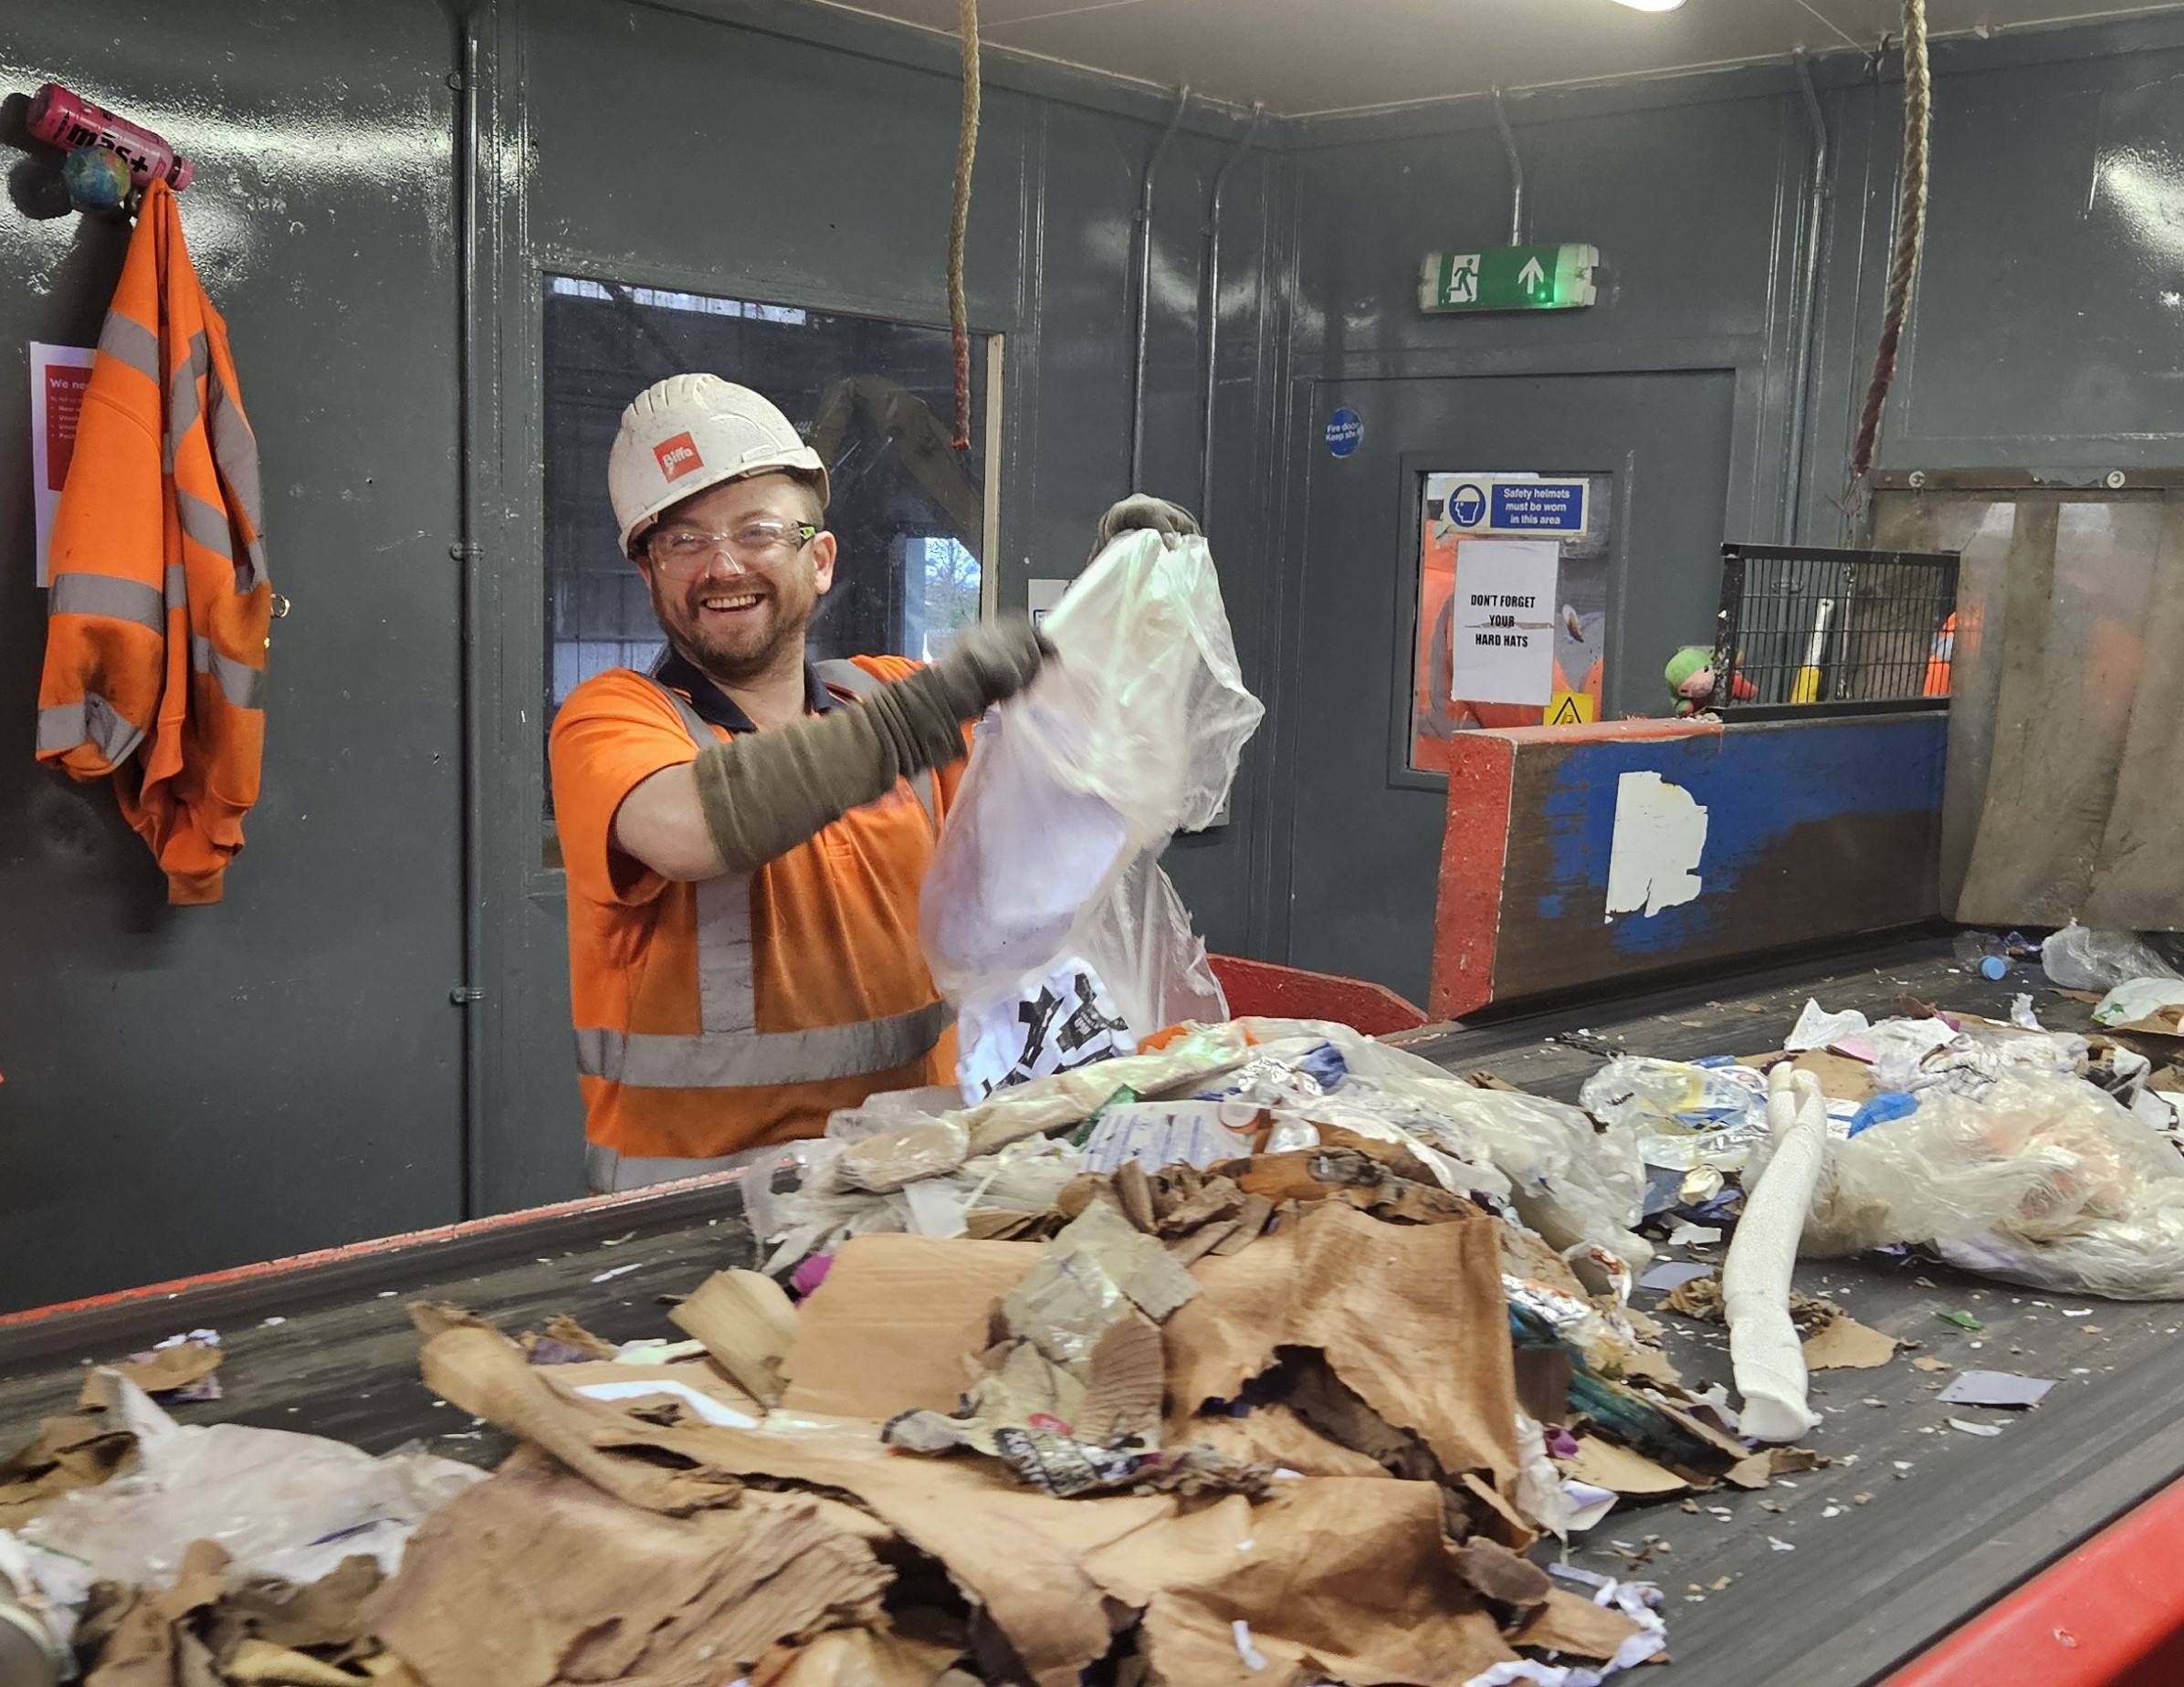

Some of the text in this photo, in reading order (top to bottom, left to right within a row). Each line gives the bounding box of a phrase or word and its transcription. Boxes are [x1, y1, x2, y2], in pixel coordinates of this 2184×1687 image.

[50, 378, 68, 389] We
[1503, 488, 1570, 499] Safety helmets
[1506, 502, 1567, 512] must be worn
[1510, 514, 1561, 525] in this area
[1471, 594, 1536, 608] DON'T FORGET
[1489, 614, 1515, 627] YOUR
[1475, 634, 1528, 647] HARD HATS
